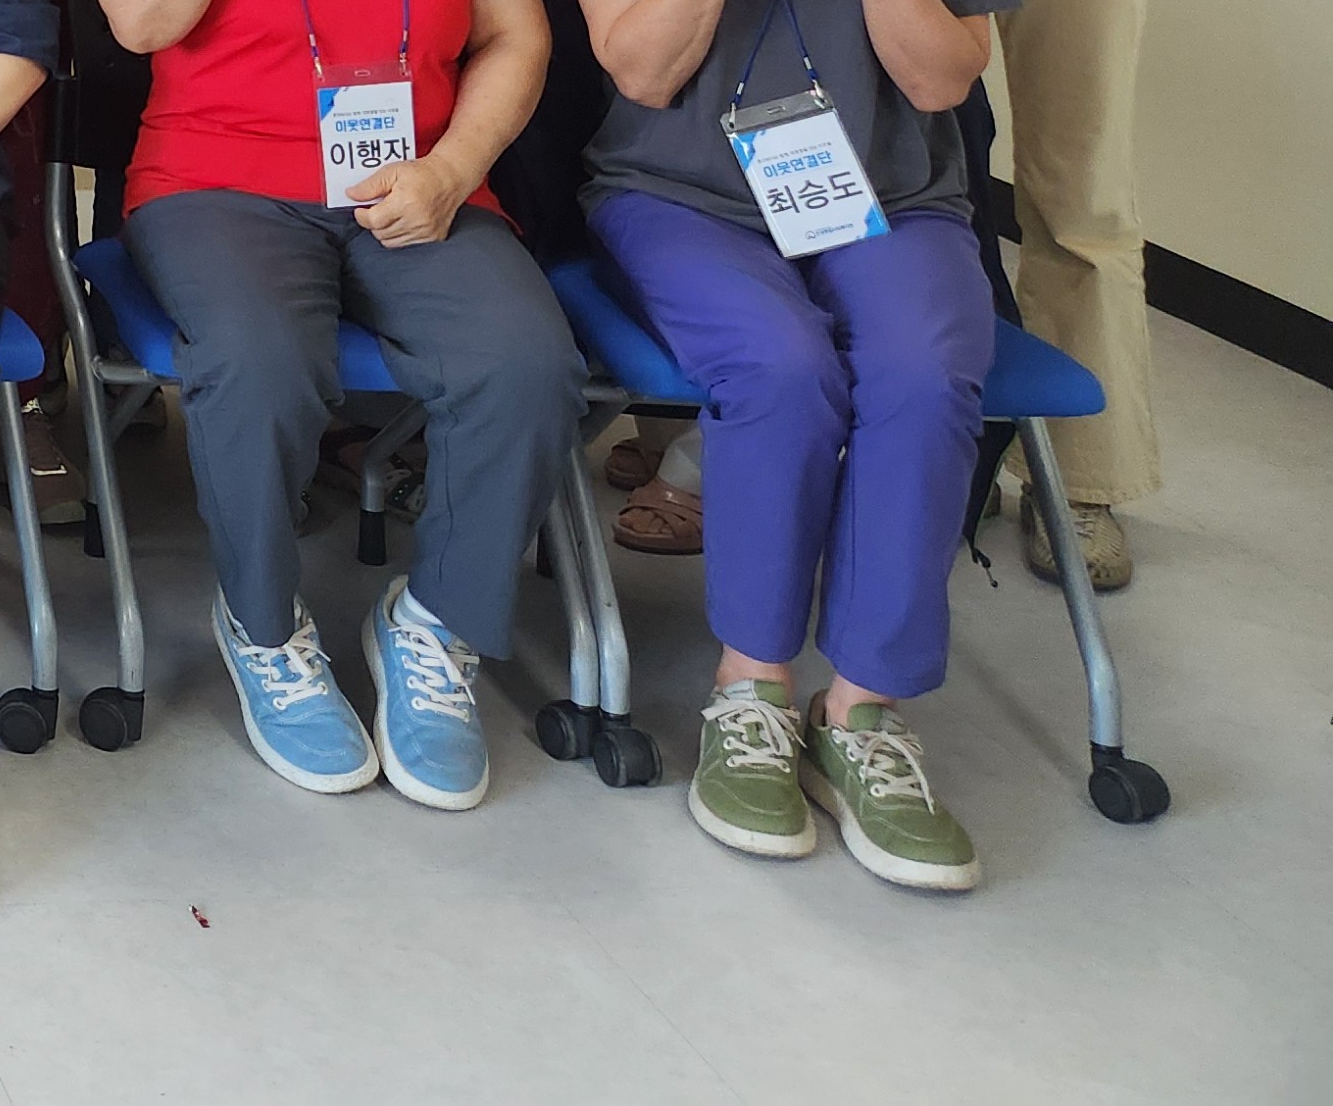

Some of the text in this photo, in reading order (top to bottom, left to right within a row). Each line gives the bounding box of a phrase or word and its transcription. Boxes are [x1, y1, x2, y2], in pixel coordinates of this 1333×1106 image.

[336, 116, 396, 133] 이웃연결단
[330, 137, 411, 169] 이행자
[763, 150, 833, 178] 이웃연결단
[767, 171, 864, 214] 최승도
